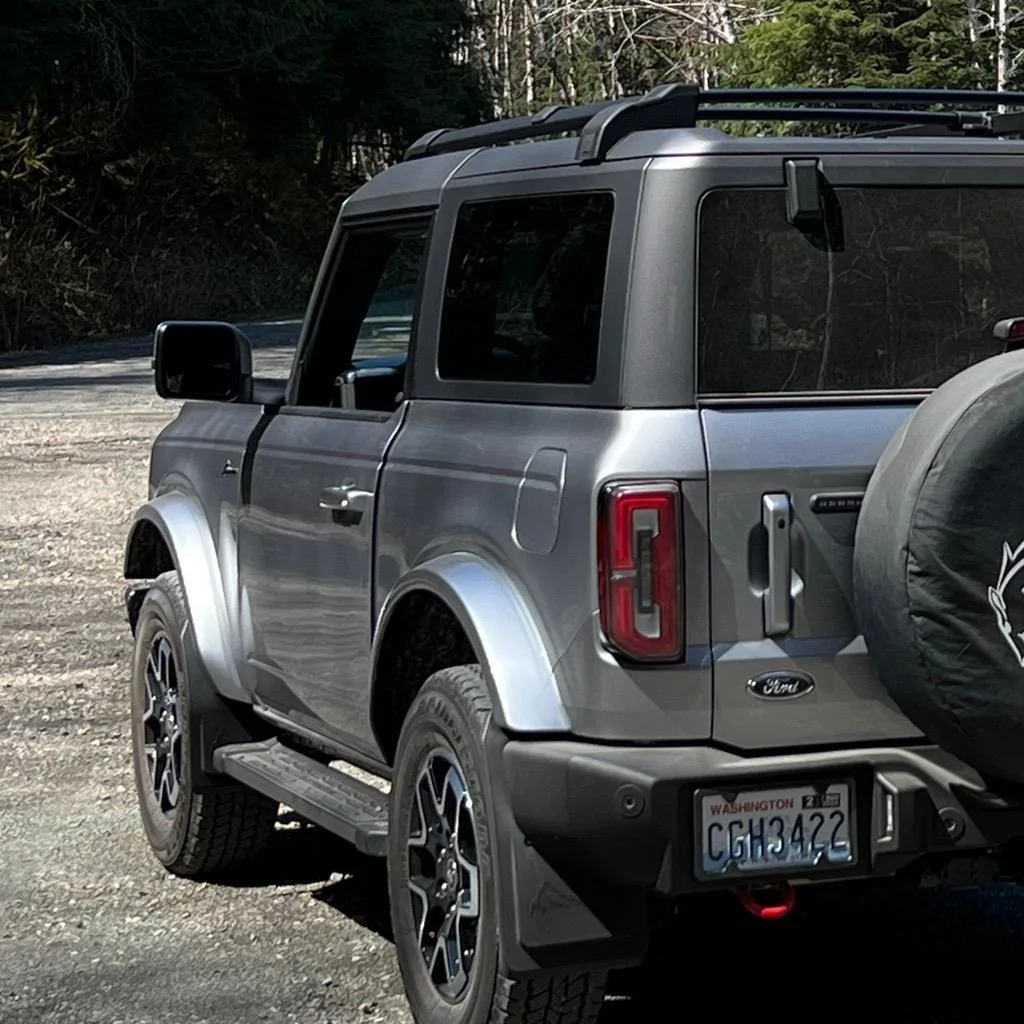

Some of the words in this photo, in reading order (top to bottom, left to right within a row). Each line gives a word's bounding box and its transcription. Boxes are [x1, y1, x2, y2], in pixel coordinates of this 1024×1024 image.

[762, 678, 800, 694] Ford
[710, 798, 795, 816] WASHINGTON
[708, 810, 845, 861] CGH3422
